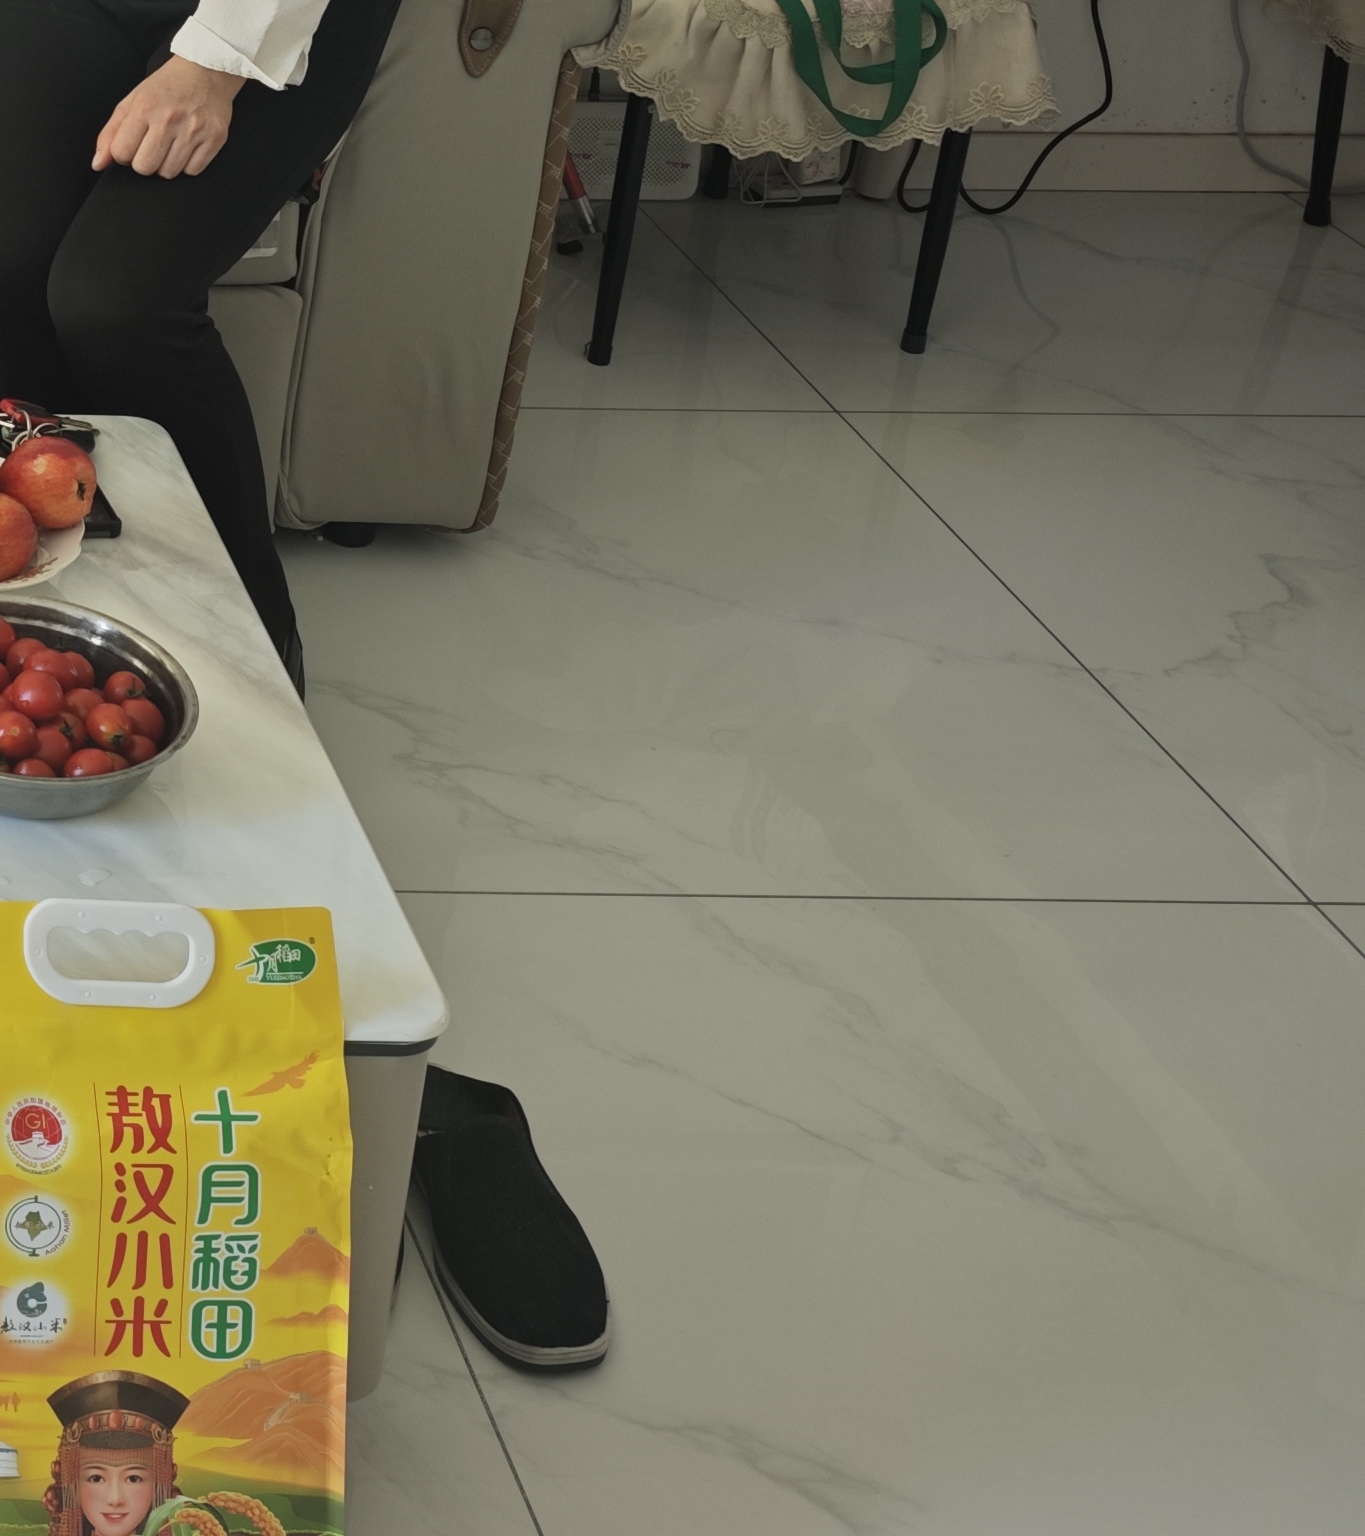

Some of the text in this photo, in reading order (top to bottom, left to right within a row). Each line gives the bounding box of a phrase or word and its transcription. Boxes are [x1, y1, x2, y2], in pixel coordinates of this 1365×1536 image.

[25, 1113, 46, 1130] GI
[104, 1084, 176, 1358] 敖汉小米
[190, 1089, 259, 1357] 十月稻田
